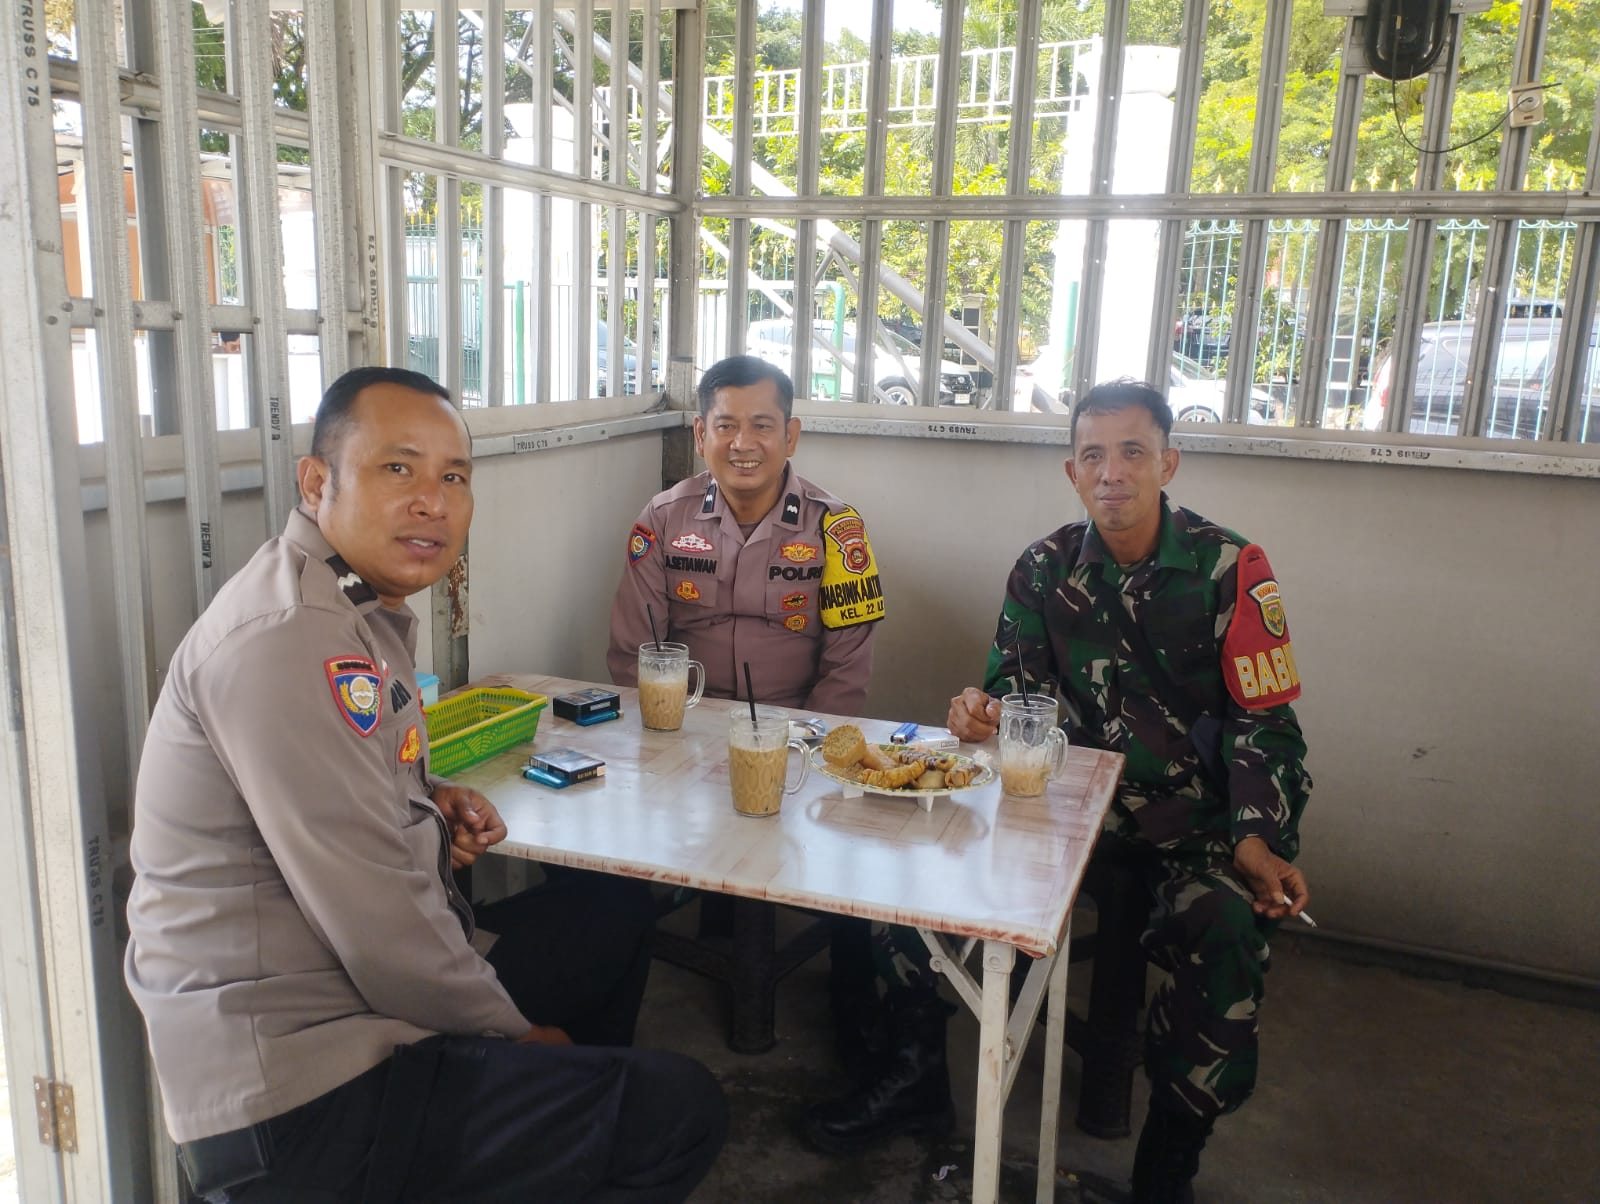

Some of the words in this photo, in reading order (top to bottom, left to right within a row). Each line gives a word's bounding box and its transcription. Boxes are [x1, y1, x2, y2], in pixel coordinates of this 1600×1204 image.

[26, 67, 38, 79] C
[27, 86, 39, 107] 75
[270, 397, 280, 431] TRENDY
[948, 426, 976, 434] TRUSS
[840, 606, 863, 621] KEL.
[866, 603, 874, 615] 22
